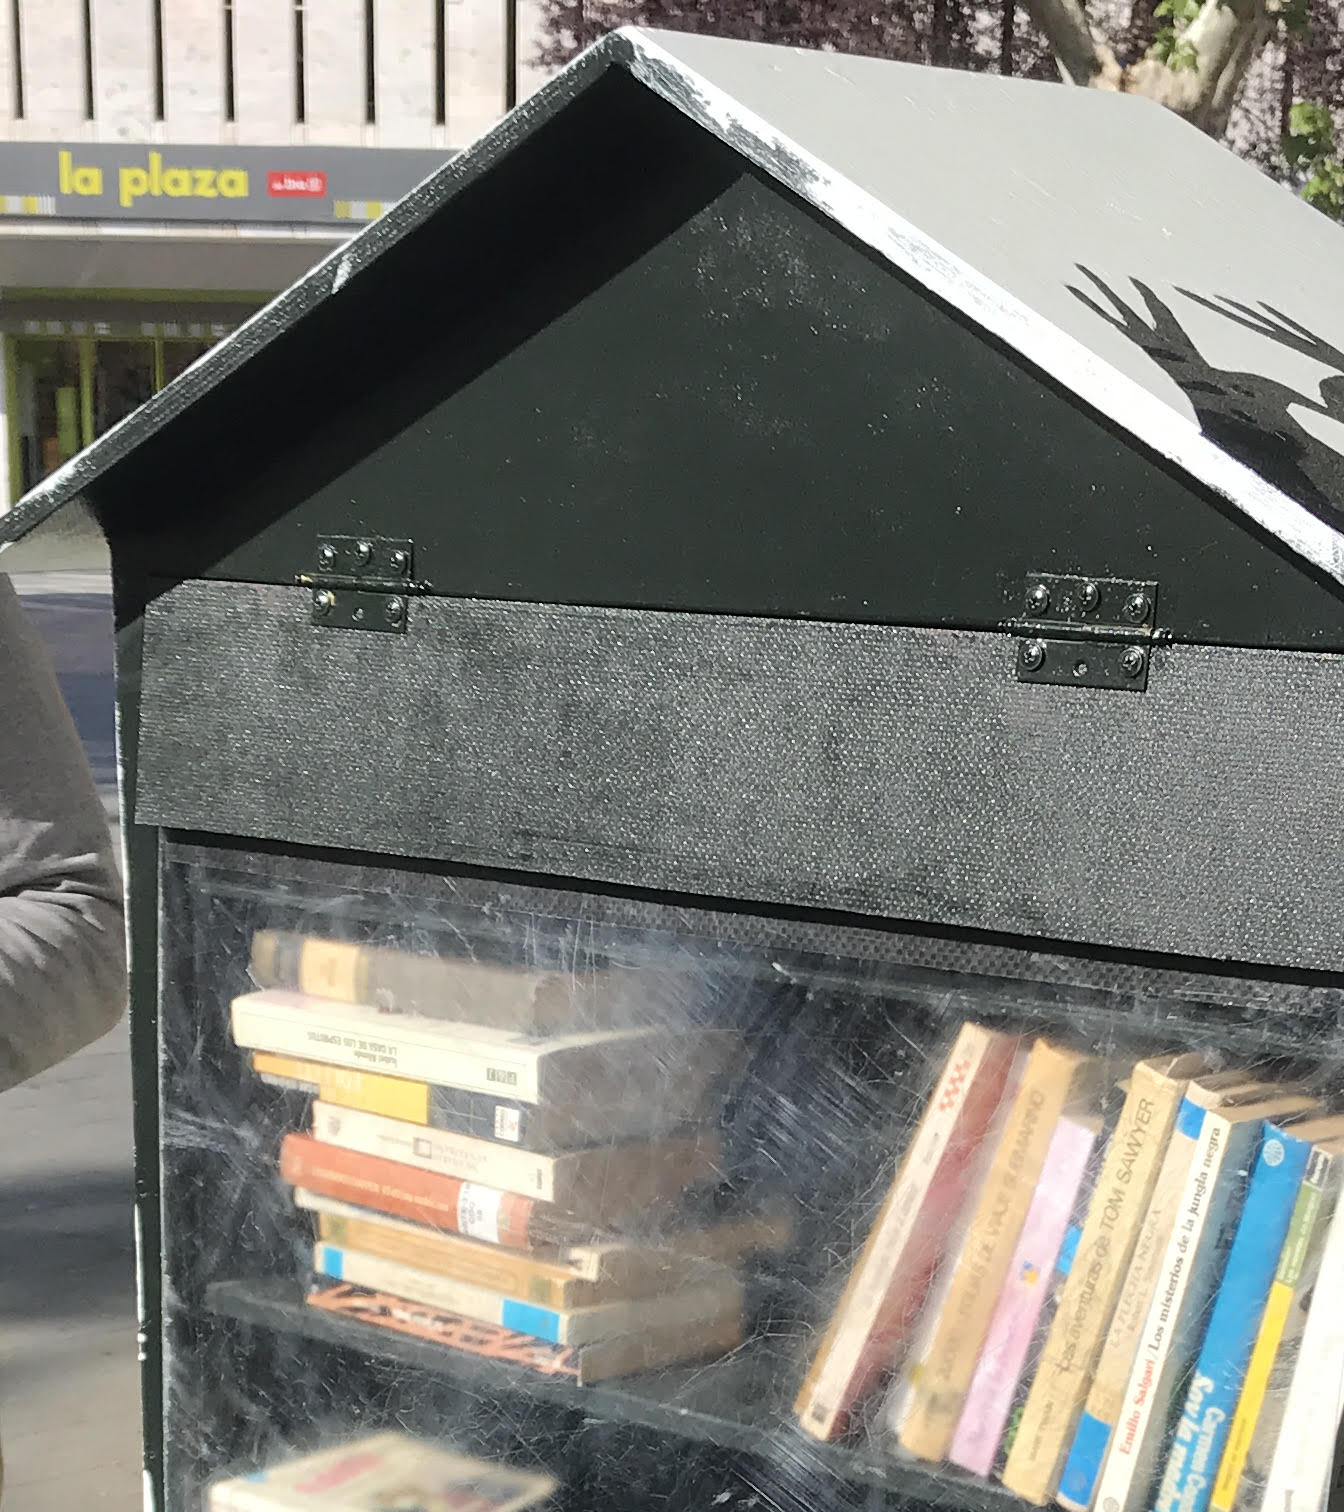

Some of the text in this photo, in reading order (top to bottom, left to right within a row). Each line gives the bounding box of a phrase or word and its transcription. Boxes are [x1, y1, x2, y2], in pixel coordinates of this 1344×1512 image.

[59, 151, 249, 208] la plaza
[1117, 1096, 1154, 1184] SAWYER
[1201, 1126, 1221, 1168] negra
[1100, 1190, 1126, 1232] TOM
[1187, 1172, 1209, 1218] jungla
[1095, 1232, 1113, 1265] de
[1180, 1238, 1190, 1254] de
[1185, 1217, 1195, 1234] la
[1068, 1261, 1103, 1342] aventuras
[1159, 1254, 1185, 1324] misterios
[1134, 1357, 1156, 1407] Salgari
[1119, 1410, 1141, 1456] Emilio
[1190, 1406, 1226, 1473] Carmen
